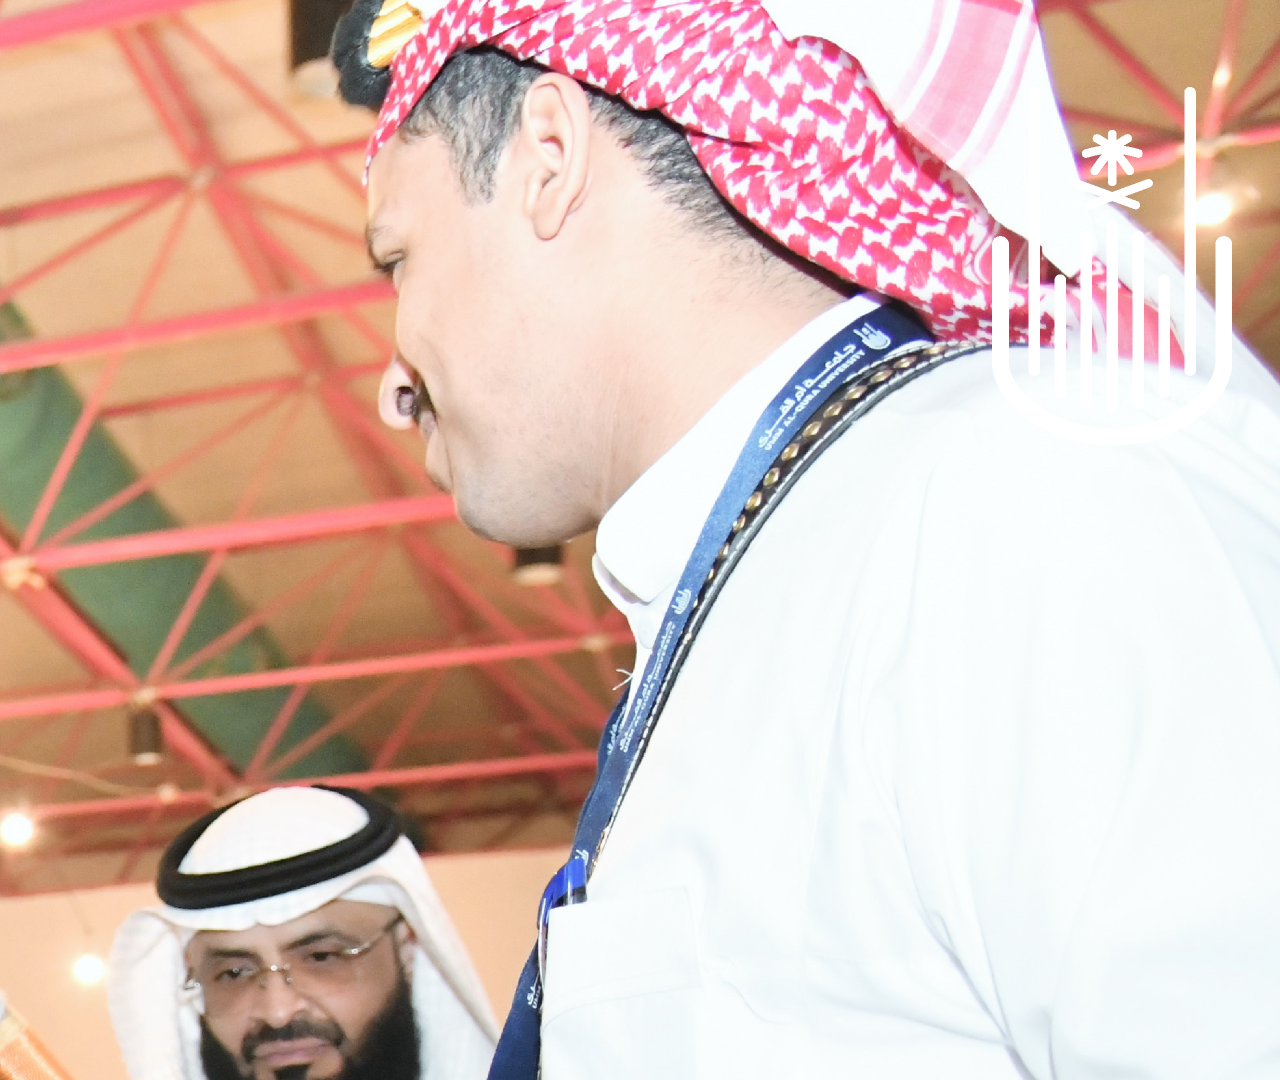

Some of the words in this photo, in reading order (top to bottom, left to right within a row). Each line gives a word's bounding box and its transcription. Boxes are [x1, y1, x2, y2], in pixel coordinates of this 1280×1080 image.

[764, 427, 785, 451] UMM
[783, 390, 820, 427] AL-QURA
[818, 349, 866, 389] UNIVERSITY
